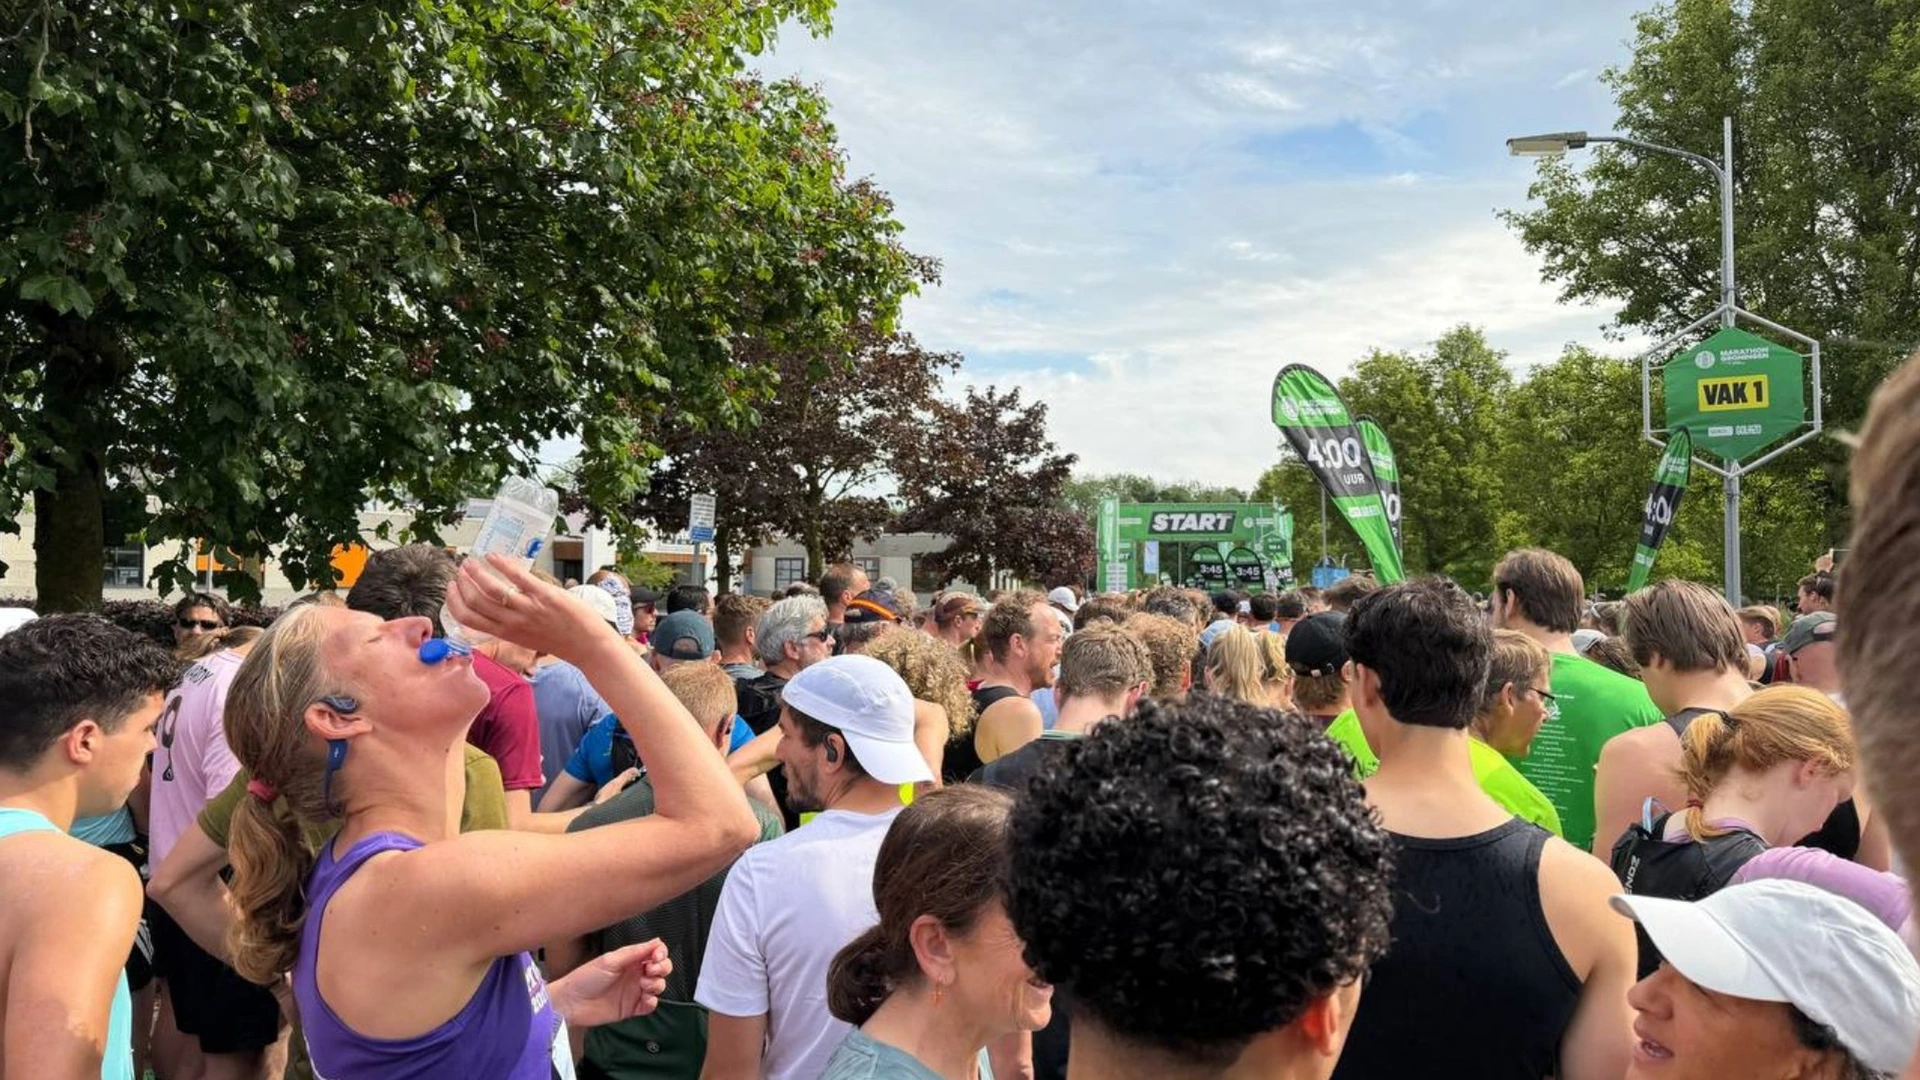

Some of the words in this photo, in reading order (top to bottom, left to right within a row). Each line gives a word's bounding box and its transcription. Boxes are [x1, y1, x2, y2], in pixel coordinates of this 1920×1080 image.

[1703, 382, 1748, 406] VAK
[1753, 380, 1763, 403] 1
[1307, 437, 1362, 470] 4:00
[1343, 472, 1365, 486] UUR
[1152, 512, 1233, 532] START
[1200, 564, 1224, 575] 3:45
[1236, 566, 1261, 577] 3:45
